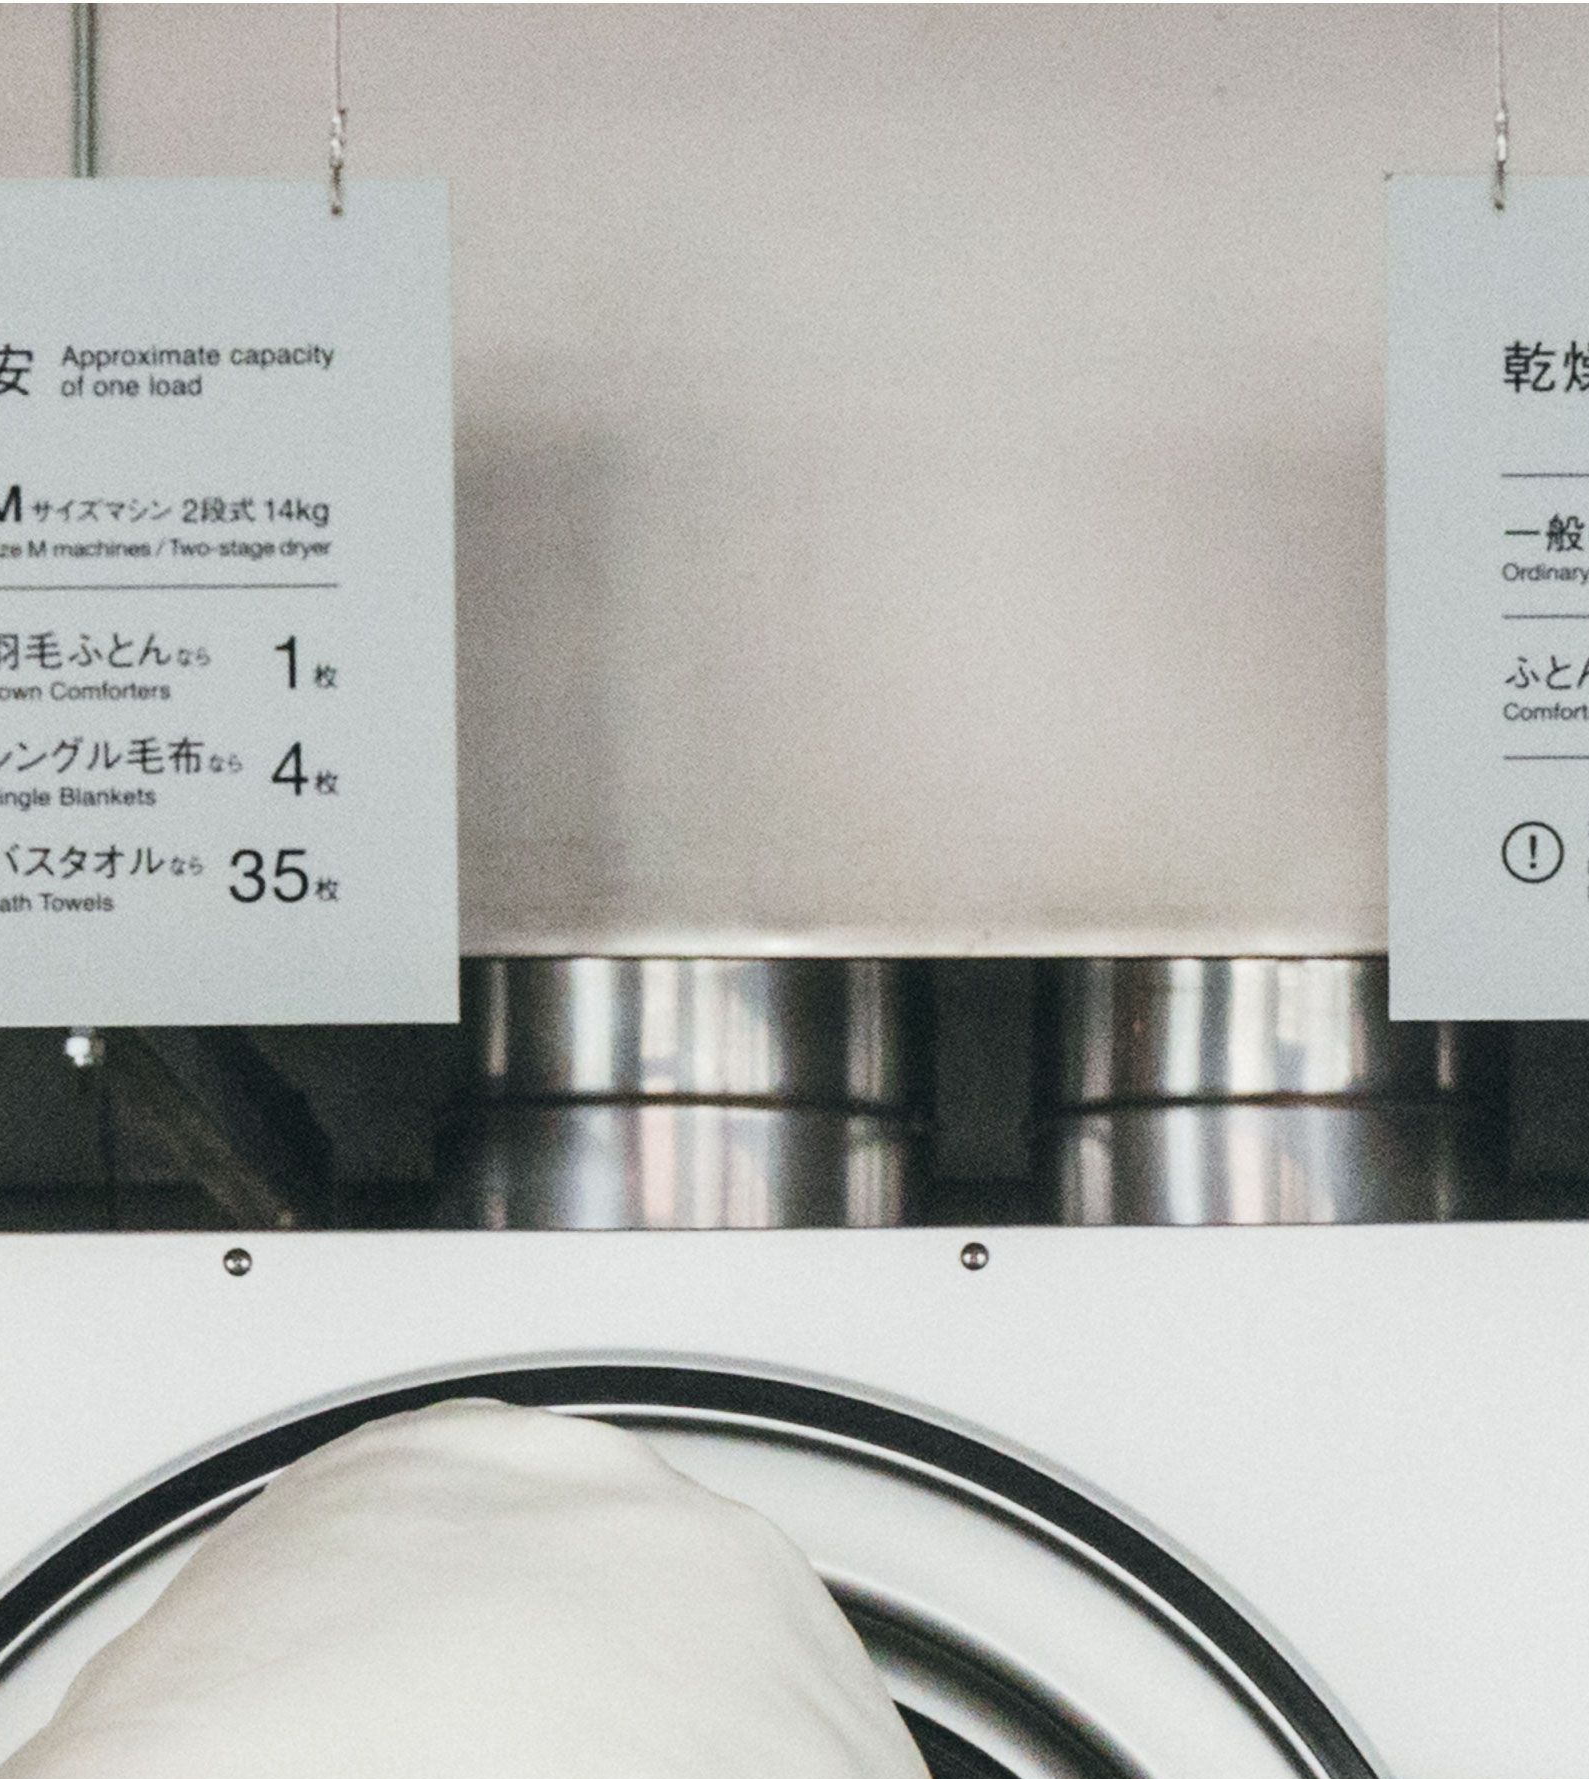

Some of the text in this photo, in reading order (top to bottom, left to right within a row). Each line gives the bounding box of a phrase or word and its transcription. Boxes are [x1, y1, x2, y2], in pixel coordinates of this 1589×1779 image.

[62, 346, 334, 371] Approximate capacity
[61, 375, 202, 397] of one load
[266, 499, 329, 527] 14kg
[27, 540, 47, 557] M
[53, 541, 151, 558] machines
[170, 538, 275, 560] Two-stage
[279, 539, 331, 559] dryer
[50, 681, 171, 701] Comforters
[59, 787, 156, 806] Blankets
[40, 893, 114, 912] Towels
